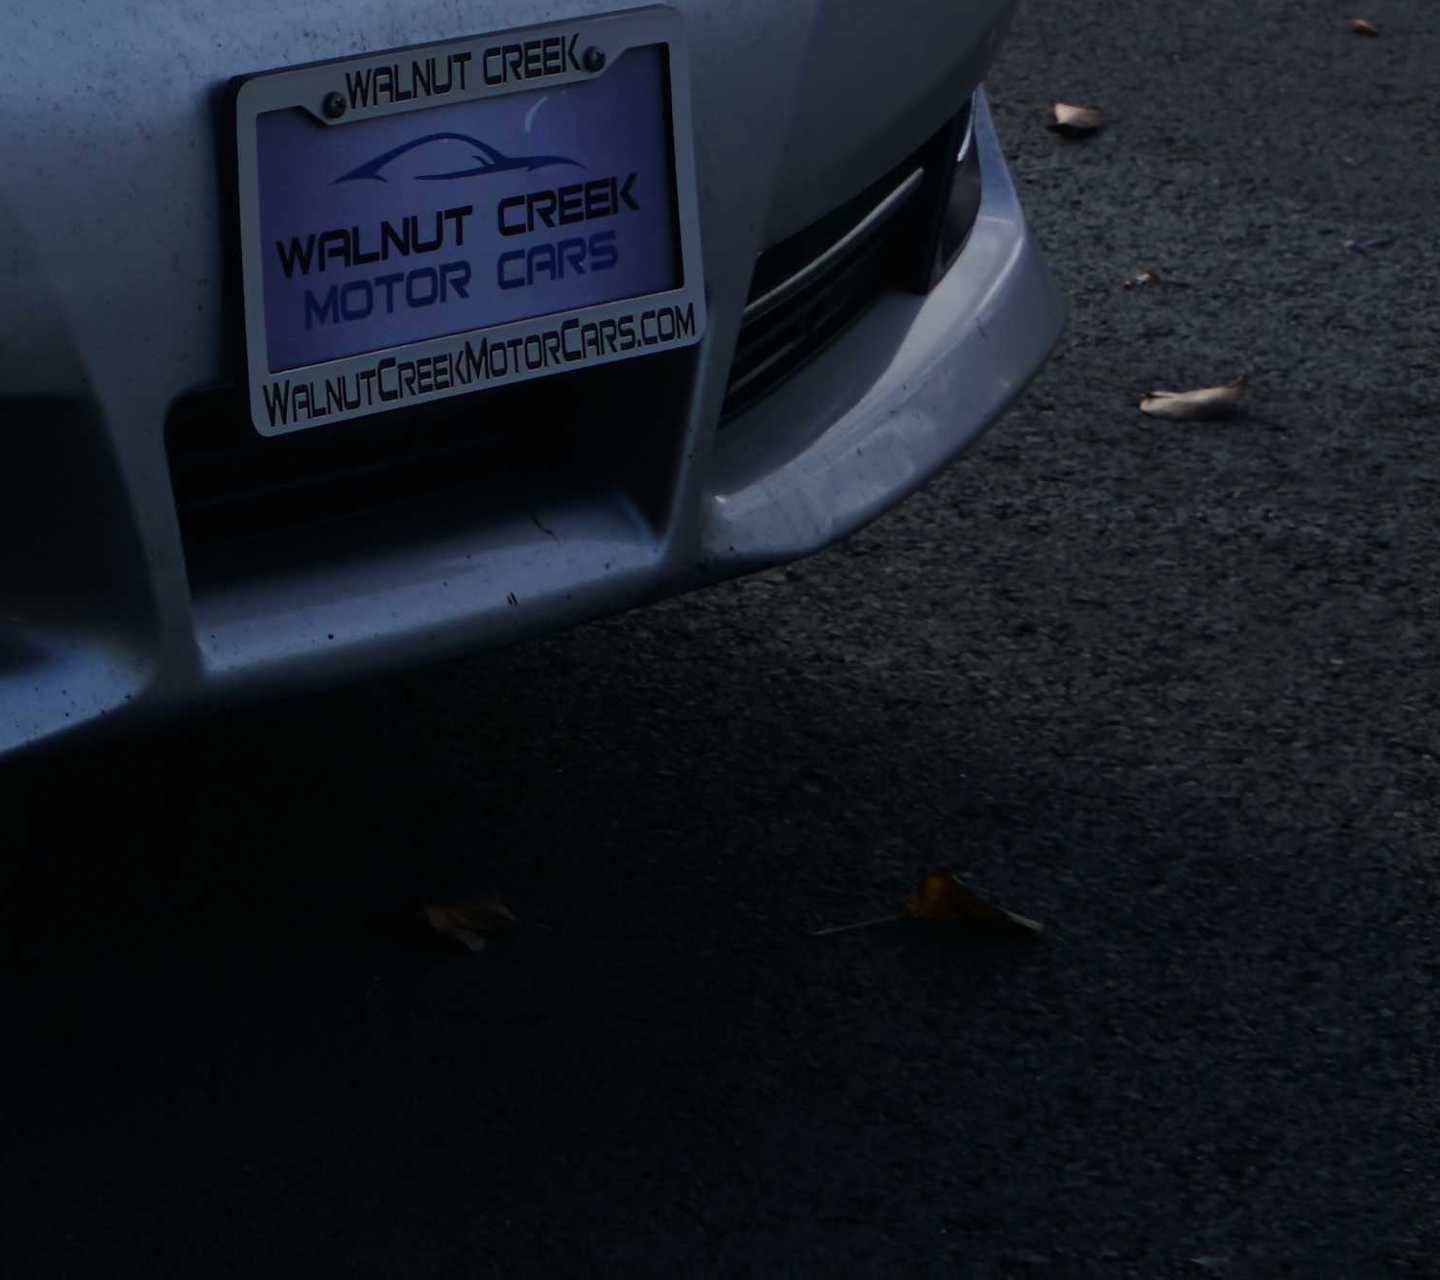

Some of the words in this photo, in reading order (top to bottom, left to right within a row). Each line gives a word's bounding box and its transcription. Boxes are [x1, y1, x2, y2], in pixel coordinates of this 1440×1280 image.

[345, 51, 472, 109] WALNUT
[482, 32, 581, 86] CREEK
[276, 204, 473, 280] WALNUT
[496, 172, 641, 237] CREEK
[303, 261, 472, 331] MOTOR
[496, 229, 620, 292] CARS
